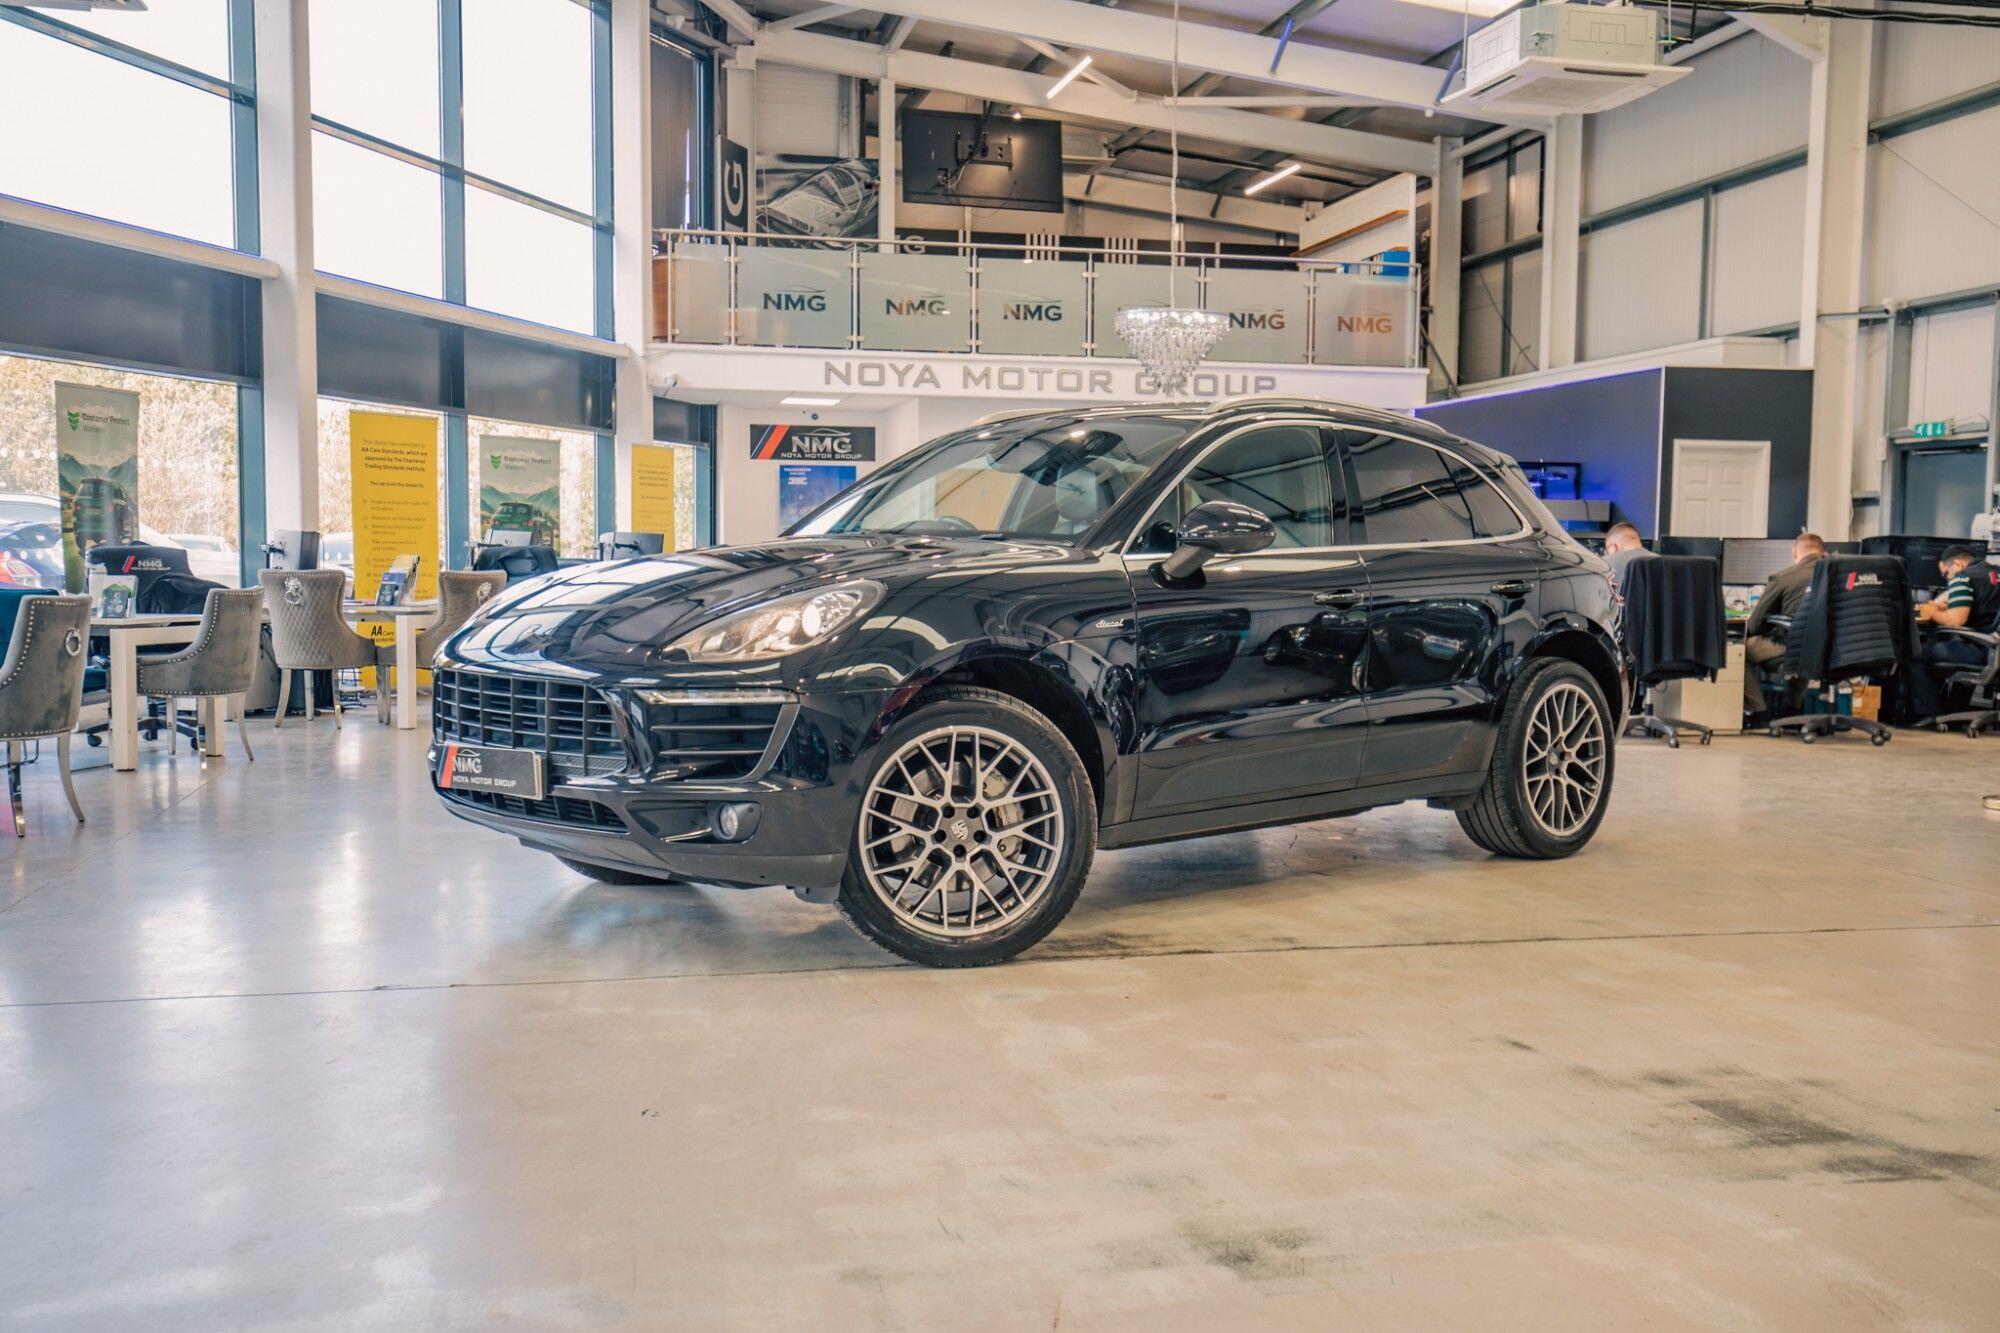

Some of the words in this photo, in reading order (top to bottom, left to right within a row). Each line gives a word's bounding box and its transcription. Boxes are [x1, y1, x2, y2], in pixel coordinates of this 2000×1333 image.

[763, 293, 826, 312] NMG
[886, 298, 947, 316] NMG
[1003, 304, 1062, 322] NMG
[1229, 312, 1286, 330] NMG
[1337, 315, 1393, 334] NMG
[824, 361, 941, 389] NOYA
[962, 365, 1113, 394] MOTOR
[791, 435, 852, 454] NMG
[138, 560, 163, 568] NMG
[371, 625, 383, 636] AA
[453, 757, 482, 774] NMG
[453, 775, 469, 783] NOYA
[471, 777, 493, 785] MOTOR
[494, 778, 517, 787] GROUP
